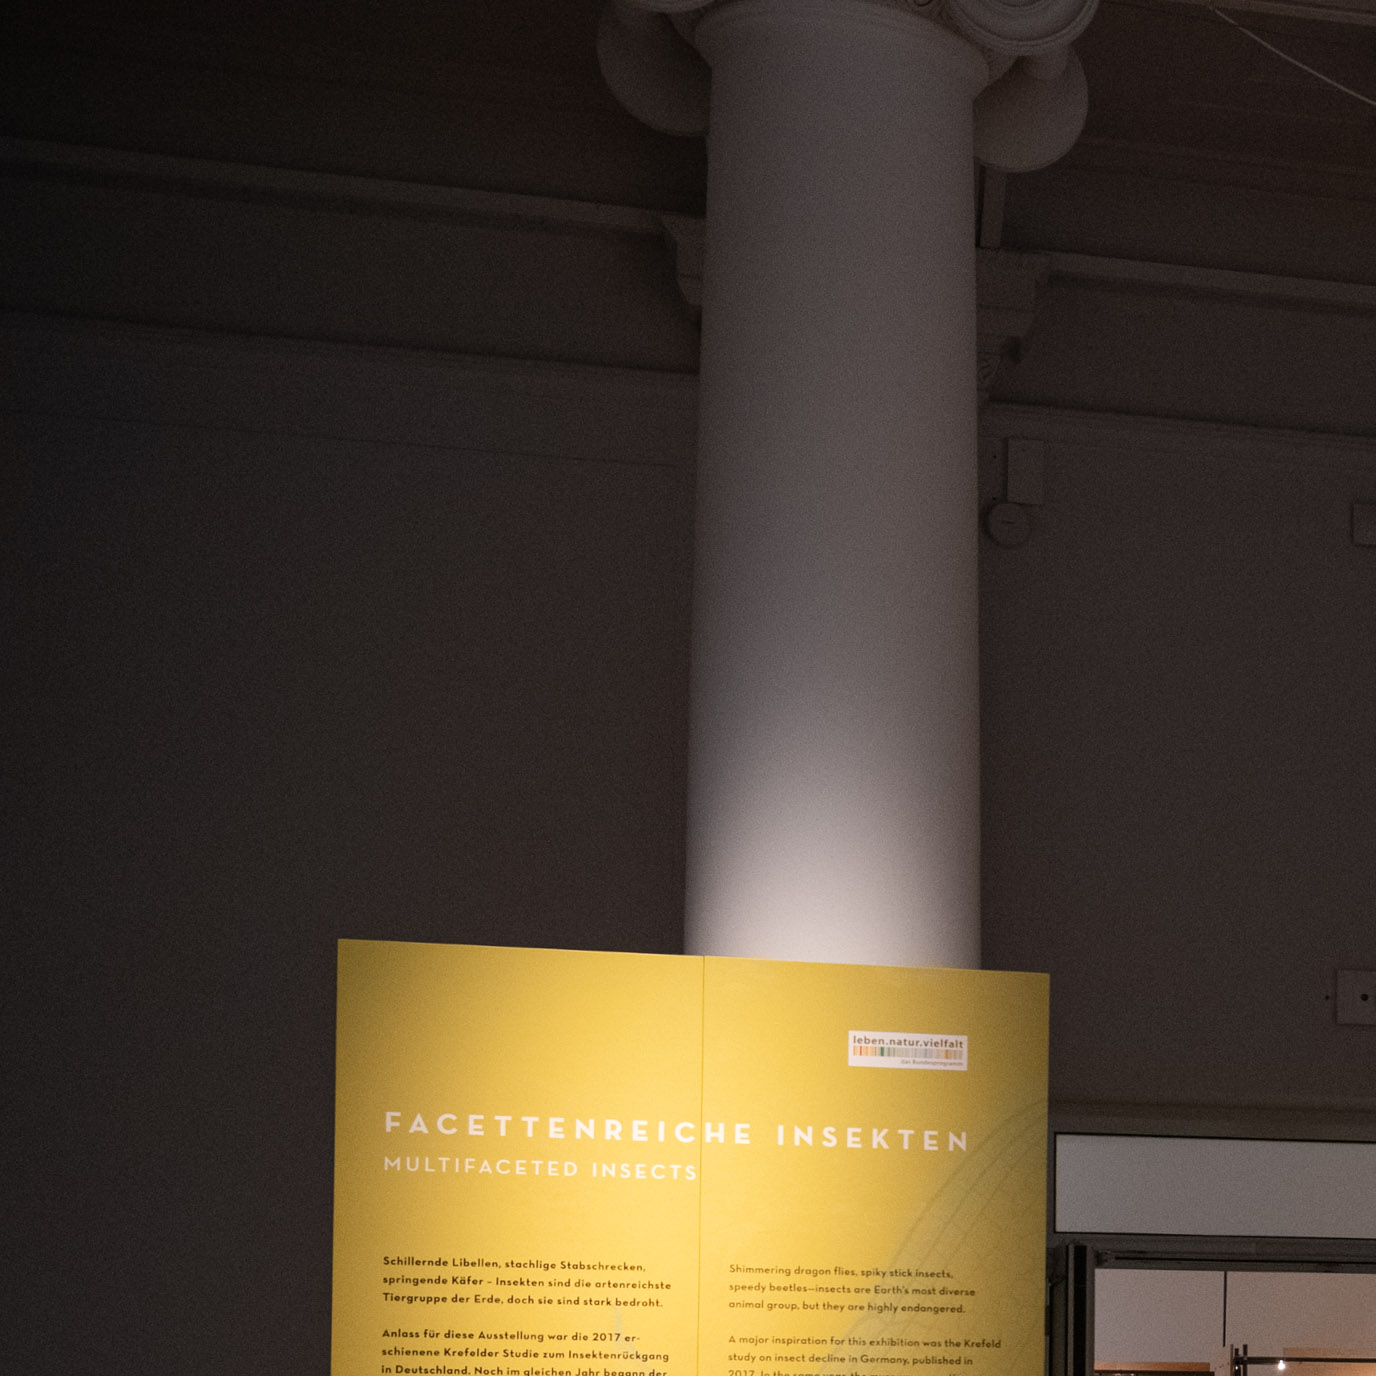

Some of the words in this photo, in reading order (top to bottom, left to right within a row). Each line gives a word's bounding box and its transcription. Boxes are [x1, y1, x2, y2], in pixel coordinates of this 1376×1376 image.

[853, 1035, 964, 1049] leben.natur.vielfalt
[385, 1111, 750, 1145] FACETTENREICHE
[777, 1124, 967, 1151] INSEKTEN
[384, 1156, 578, 1177] MULTIFACETED
[592, 1162, 696, 1181] INSECTS
[382, 1255, 449, 1268] Schillernde
[451, 1256, 502, 1270] Libellen,
[504, 1258, 557, 1273] stachlige
[559, 1259, 646, 1272] Stabschrecken,
[729, 1263, 791, 1277] Shimmering
[794, 1264, 831, 1279] dragon
[834, 1265, 858, 1277] flies,
[861, 1267, 888, 1279] spiky
[889, 1267, 912, 1279] stick
[915, 1268, 954, 1279] insects,
[382, 1273, 449, 1288] springende
[451, 1274, 484, 1287] Käfer
[495, 1276, 545, 1288] Insekten
[547, 1277, 571, 1288] sind
[573, 1278, 592, 1289] die
[594, 1279, 672, 1291] artenreichste
[728, 1281, 767, 1294] speedy
[853, 1287, 872, 1295] are
[911, 1286, 937, 1297] most
[938, 1285, 977, 1297] diverse
[381, 1291, 448, 1305] Tiergruppe
[450, 1292, 471, 1304] der
[473, 1293, 504, 1306] Erde,
[506, 1294, 535, 1305] doch
[537, 1295, 554, 1306] sie
[556, 1295, 581, 1306] sind
[583, 1296, 612, 1307] stark
[614, 1297, 664, 1308] bedroht.
[728, 1299, 765, 1310] animal
[766, 1301, 800, 1313] group,
[802, 1300, 820, 1311] but
[822, 1300, 846, 1313] they
[847, 1304, 866, 1312] are
[867, 1301, 899, 1315] highly
[900, 1302, 967, 1316] endangered.
